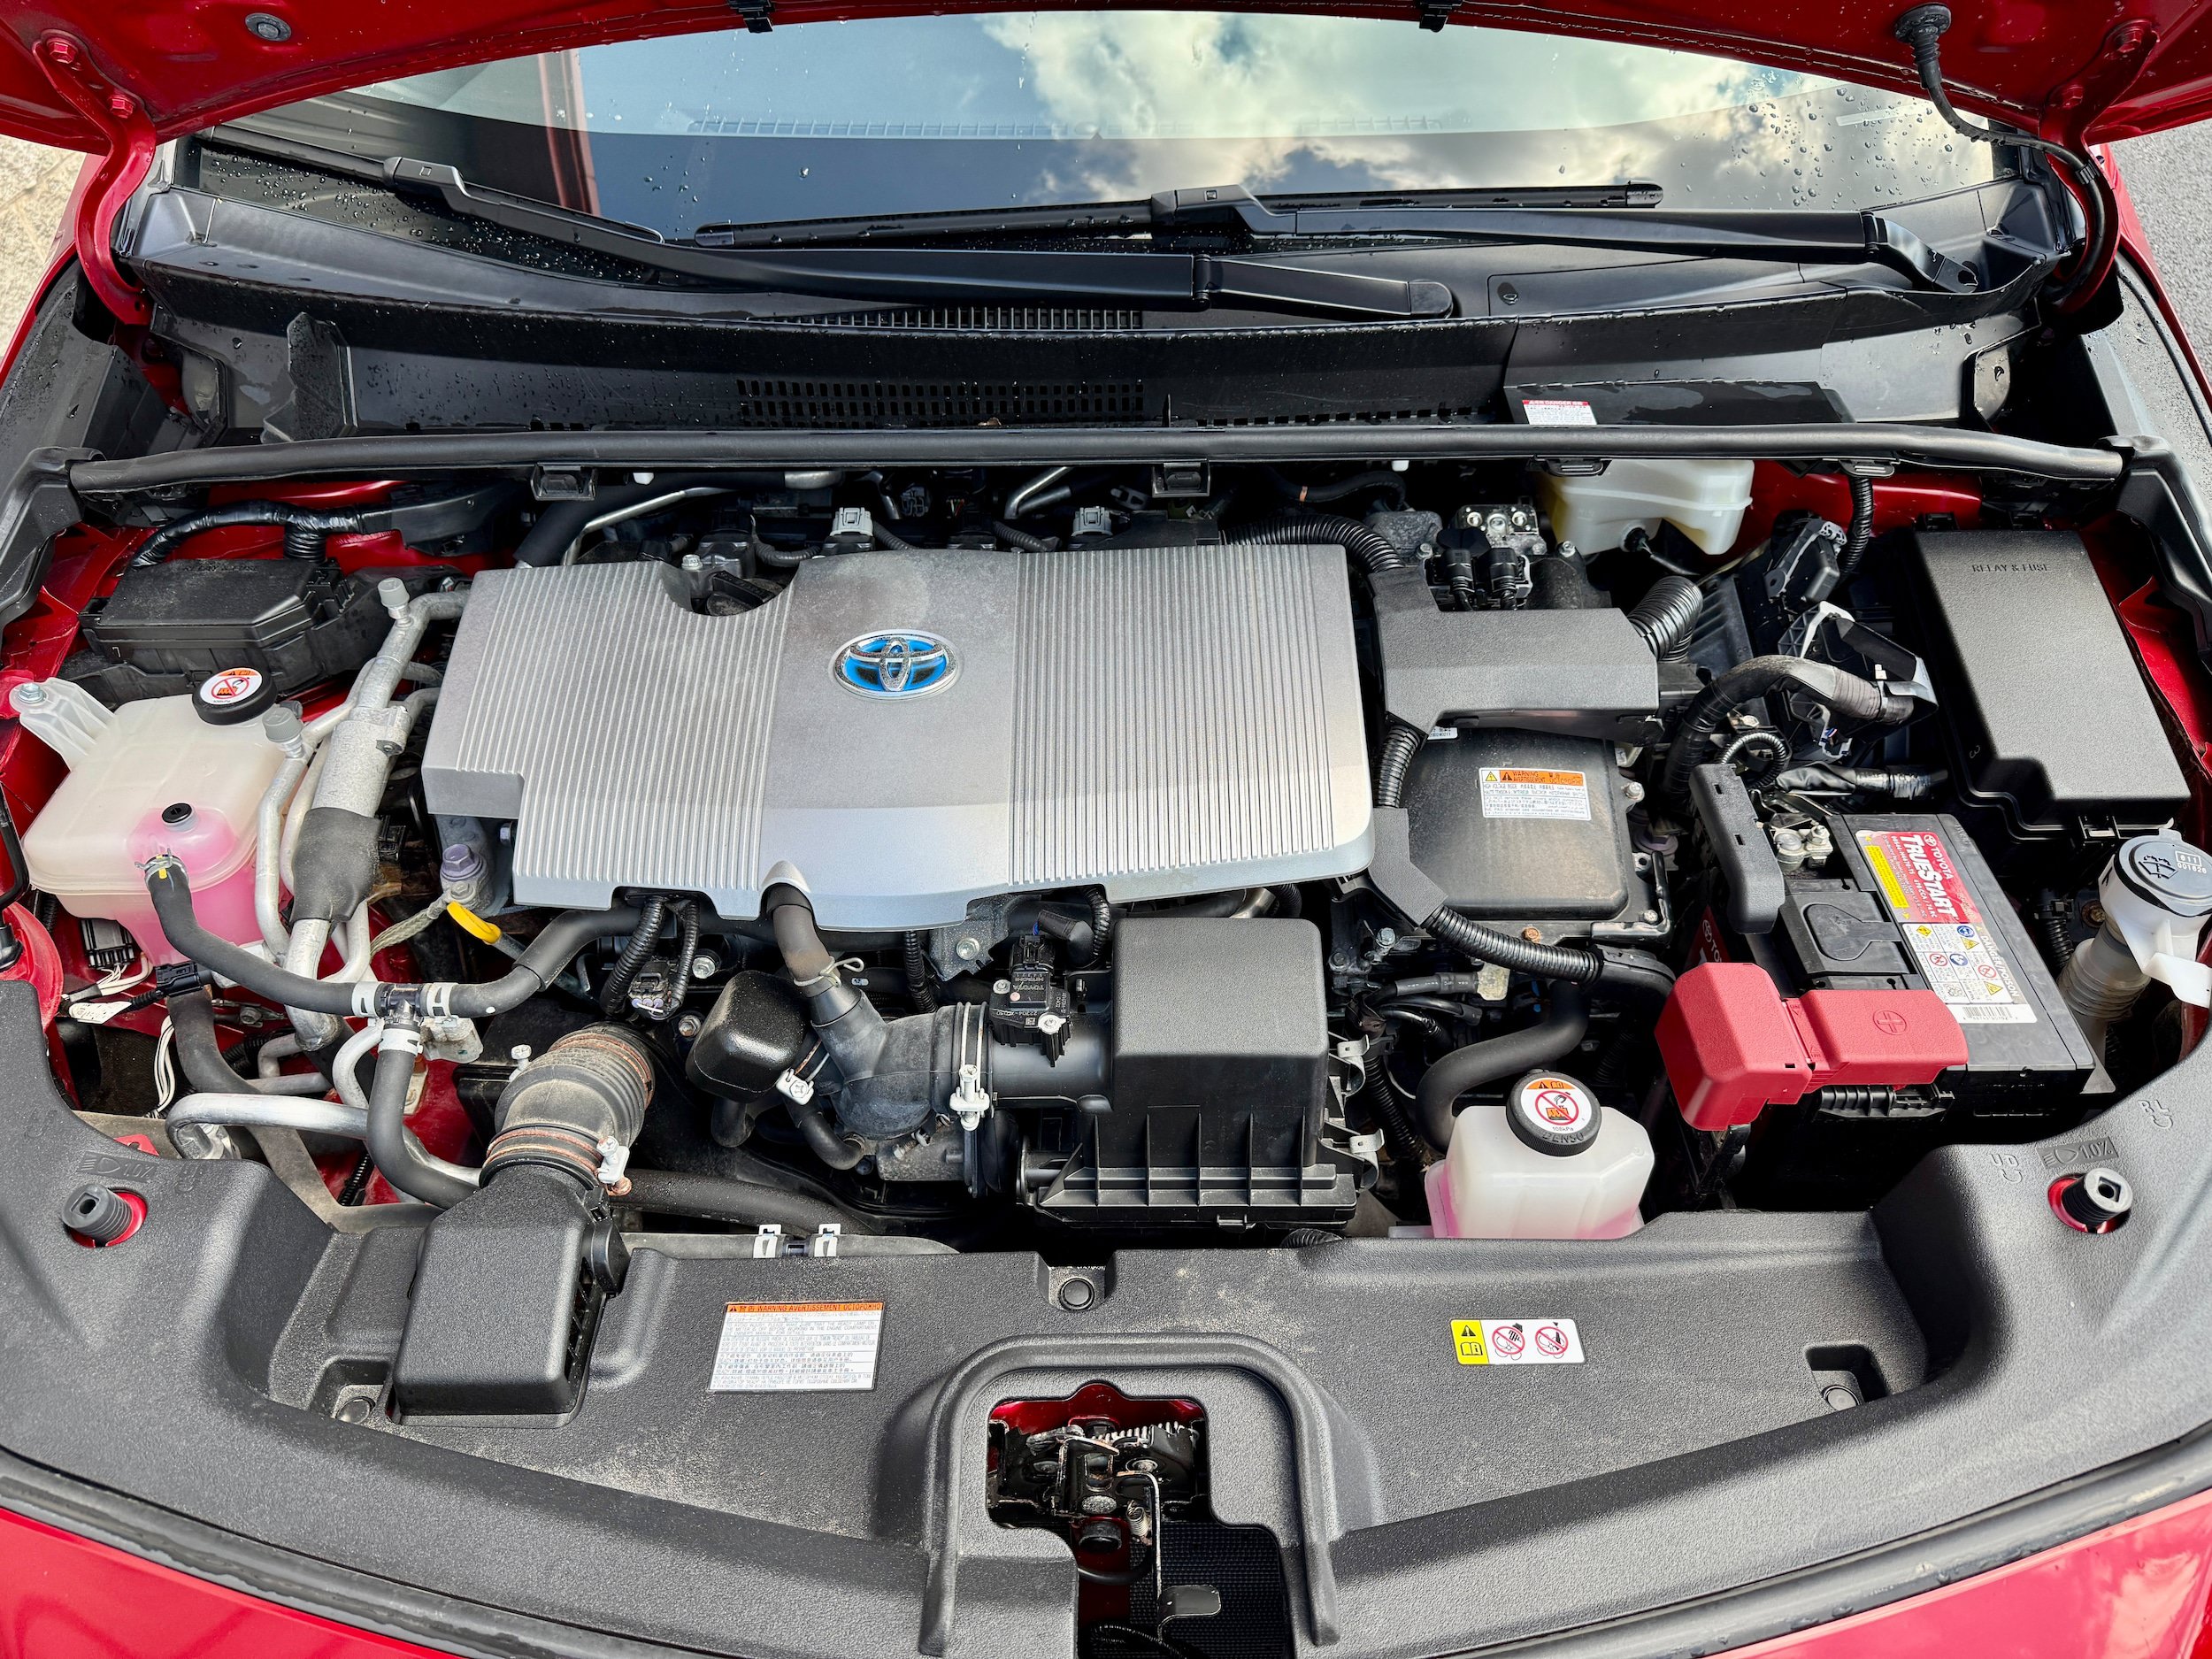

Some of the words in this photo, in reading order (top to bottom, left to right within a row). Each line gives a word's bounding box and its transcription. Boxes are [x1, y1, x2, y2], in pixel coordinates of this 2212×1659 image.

[1971, 564, 2008, 572] RELAY
[2011, 564, 2019, 572] &
[2022, 563, 2048, 572] FUSE
[1931, 847, 1954, 879] TOYOTA
[1981, 934, 2020, 998] DANGER/POISON
[1542, 1132, 1585, 1143] DENSO
[2081, 1141, 2114, 1160] 1.0%
[123, 1163, 155, 1179] 1.0%
